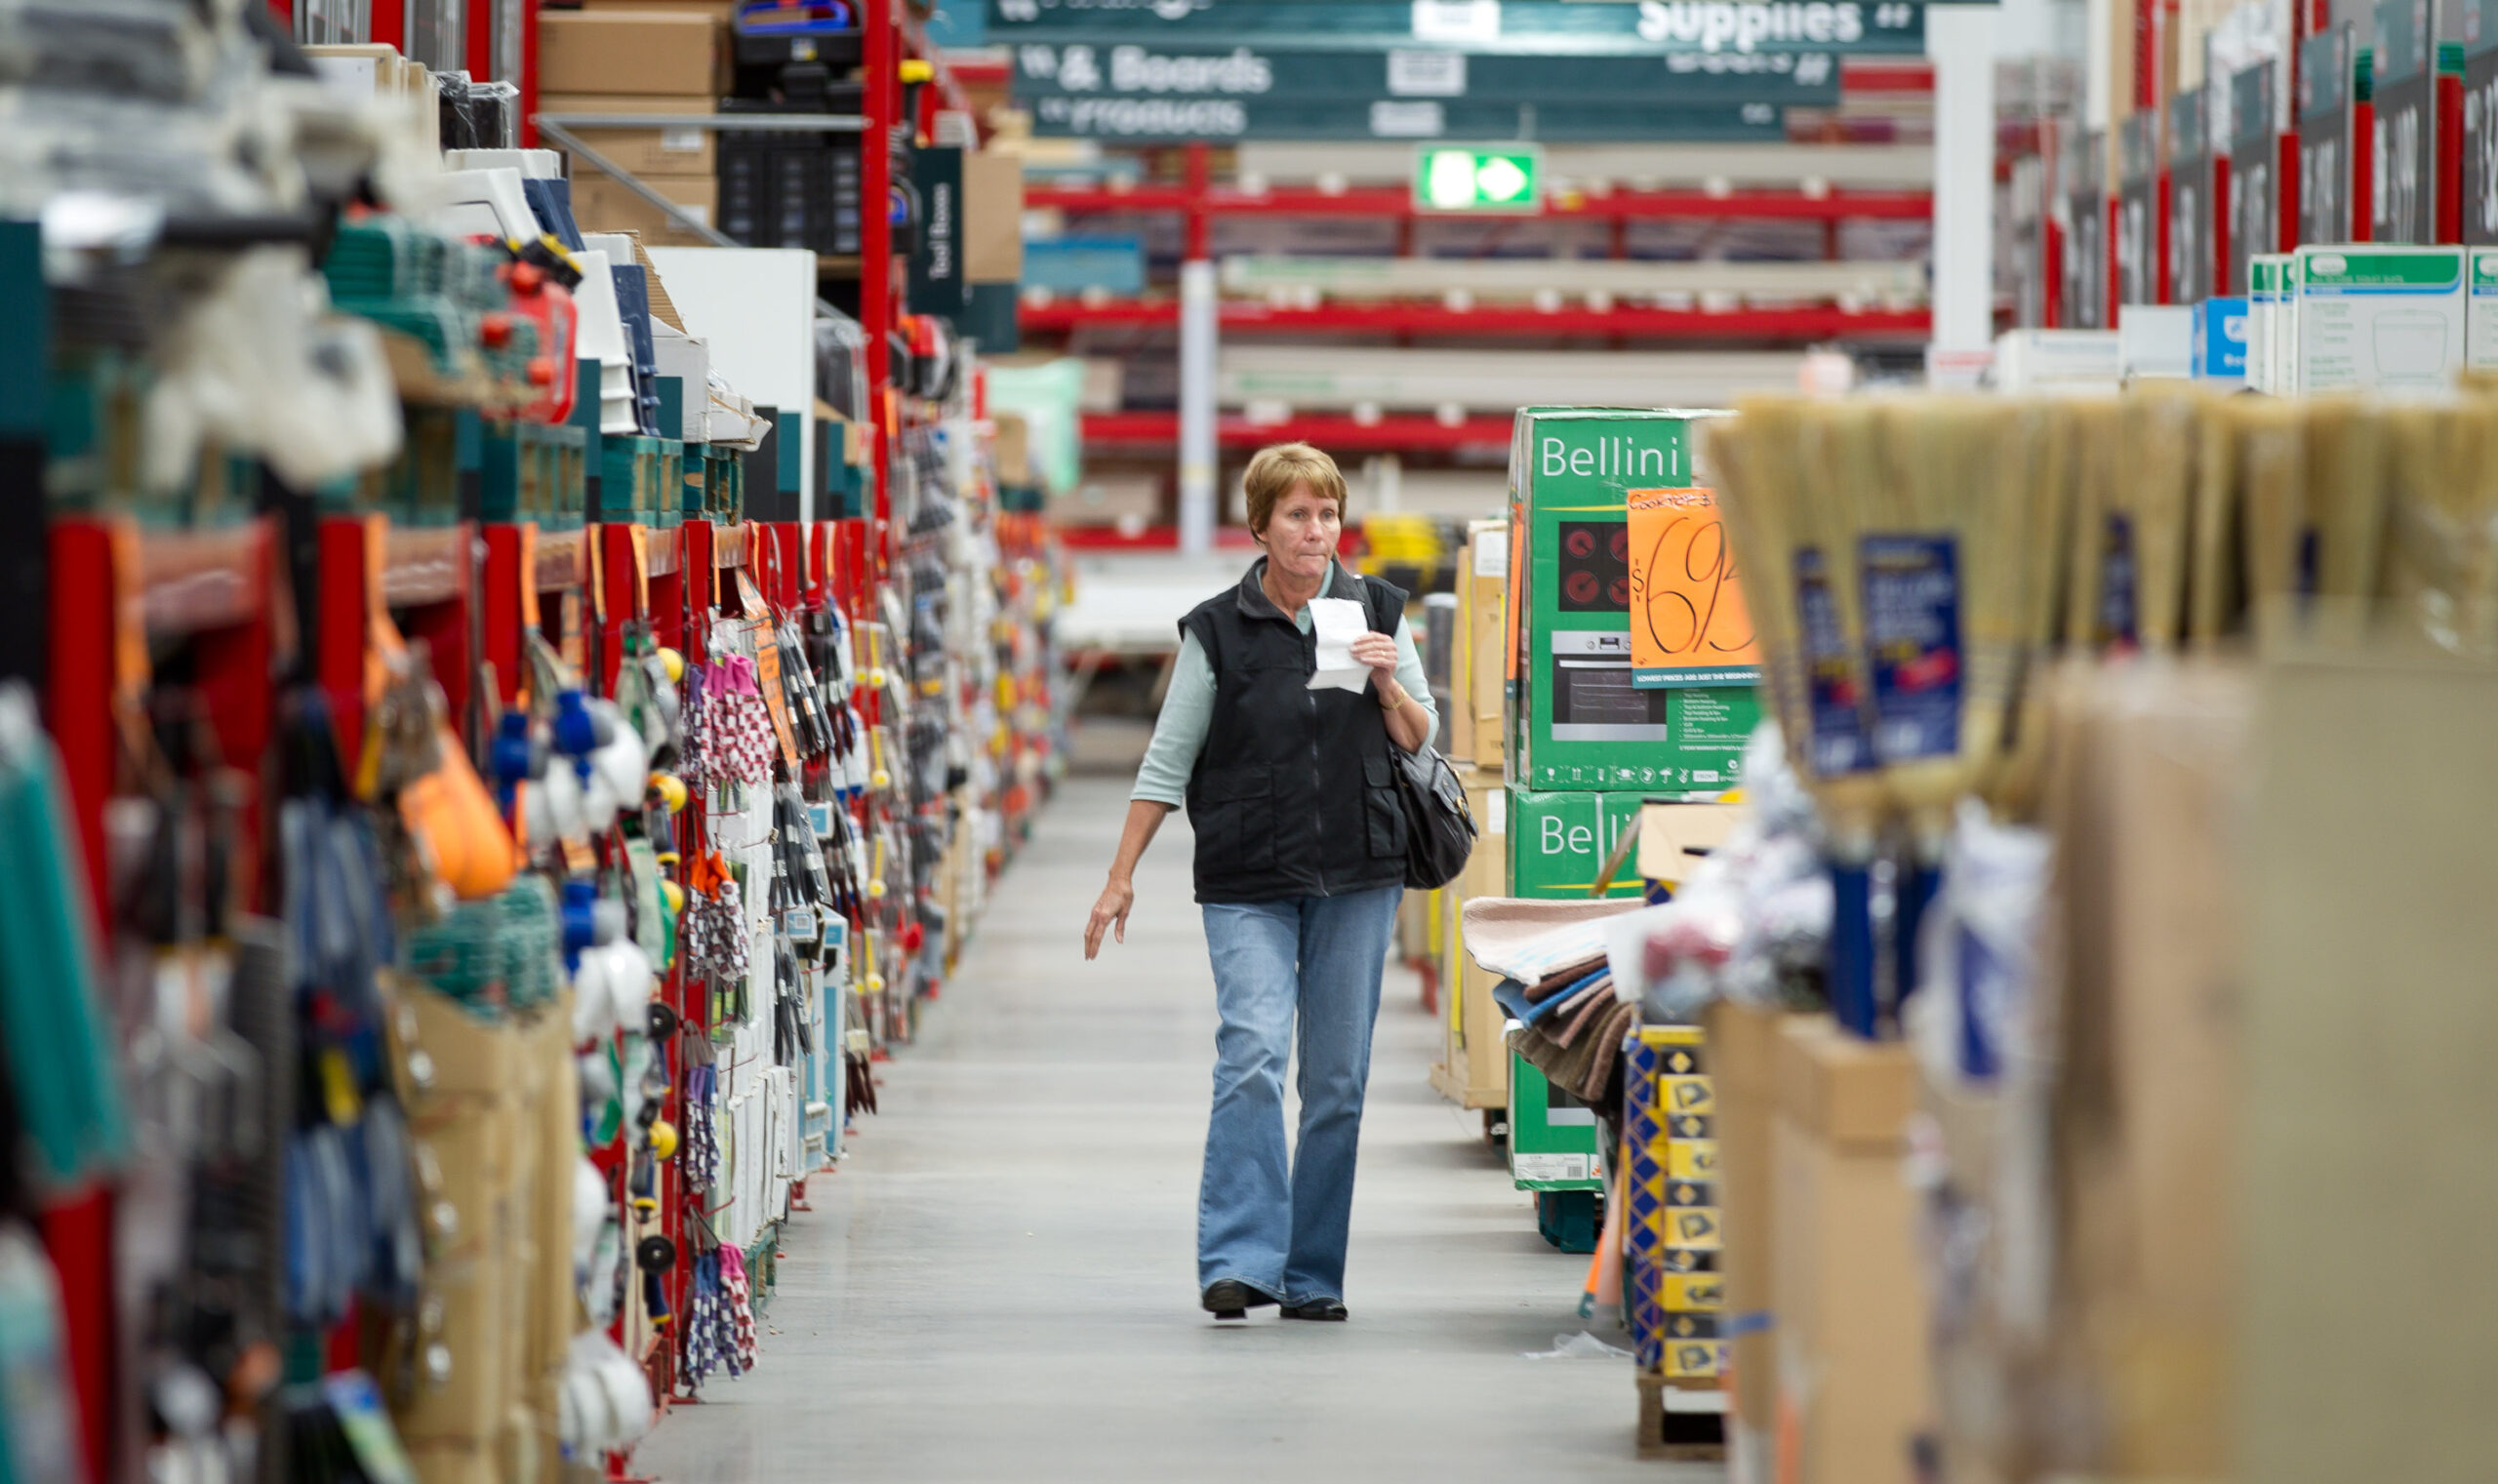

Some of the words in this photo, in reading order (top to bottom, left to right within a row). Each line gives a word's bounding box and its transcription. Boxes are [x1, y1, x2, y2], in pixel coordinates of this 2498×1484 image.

[1637, 1, 1863, 52] Supplies
[1110, 44, 1272, 93] Boards
[1543, 436, 1677, 476] Bellini
